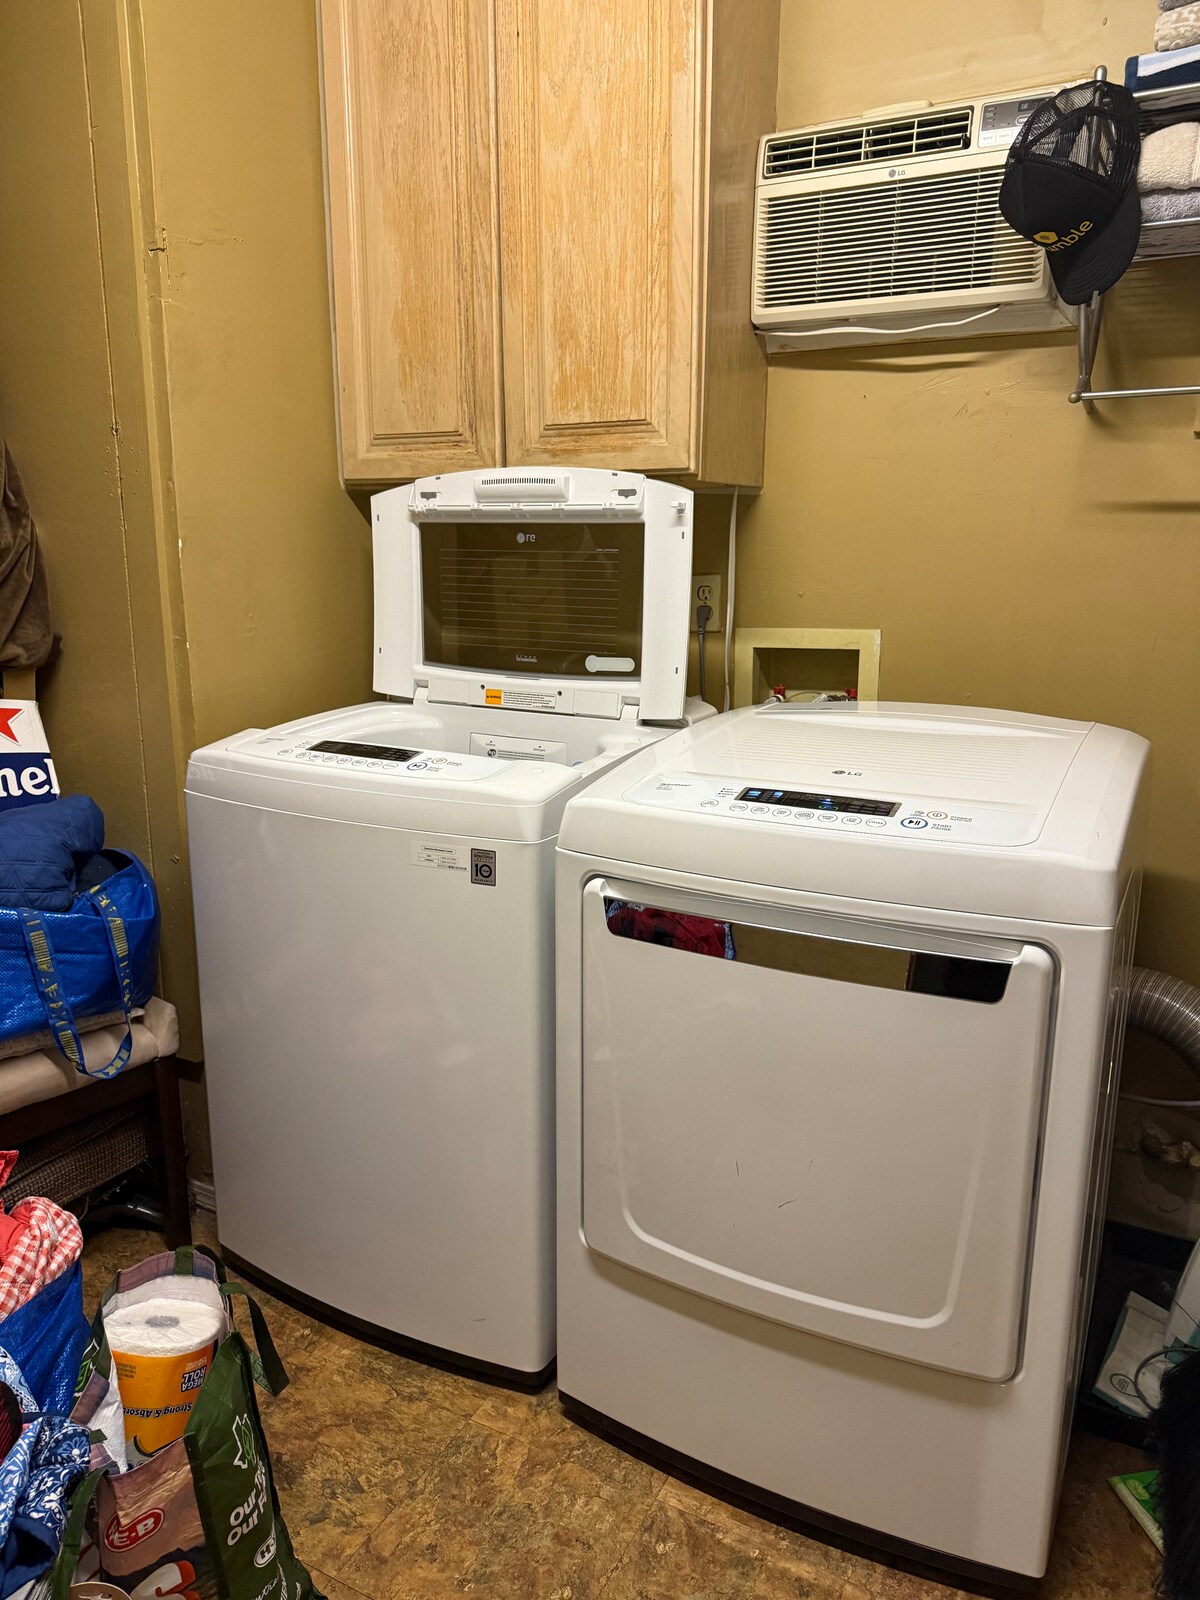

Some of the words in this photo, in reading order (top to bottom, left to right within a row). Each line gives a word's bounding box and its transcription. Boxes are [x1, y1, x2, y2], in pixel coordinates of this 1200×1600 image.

[897, 169, 906, 177] LG
[1046, 220, 1094, 252] umble
[184, 1366, 206, 1383] ROLL
[154, 1408, 161, 1418] &
[164, 1402, 192, 1416] Strong
[230, 1487, 256, 1527] Our
[226, 1508, 259, 1546] Our
